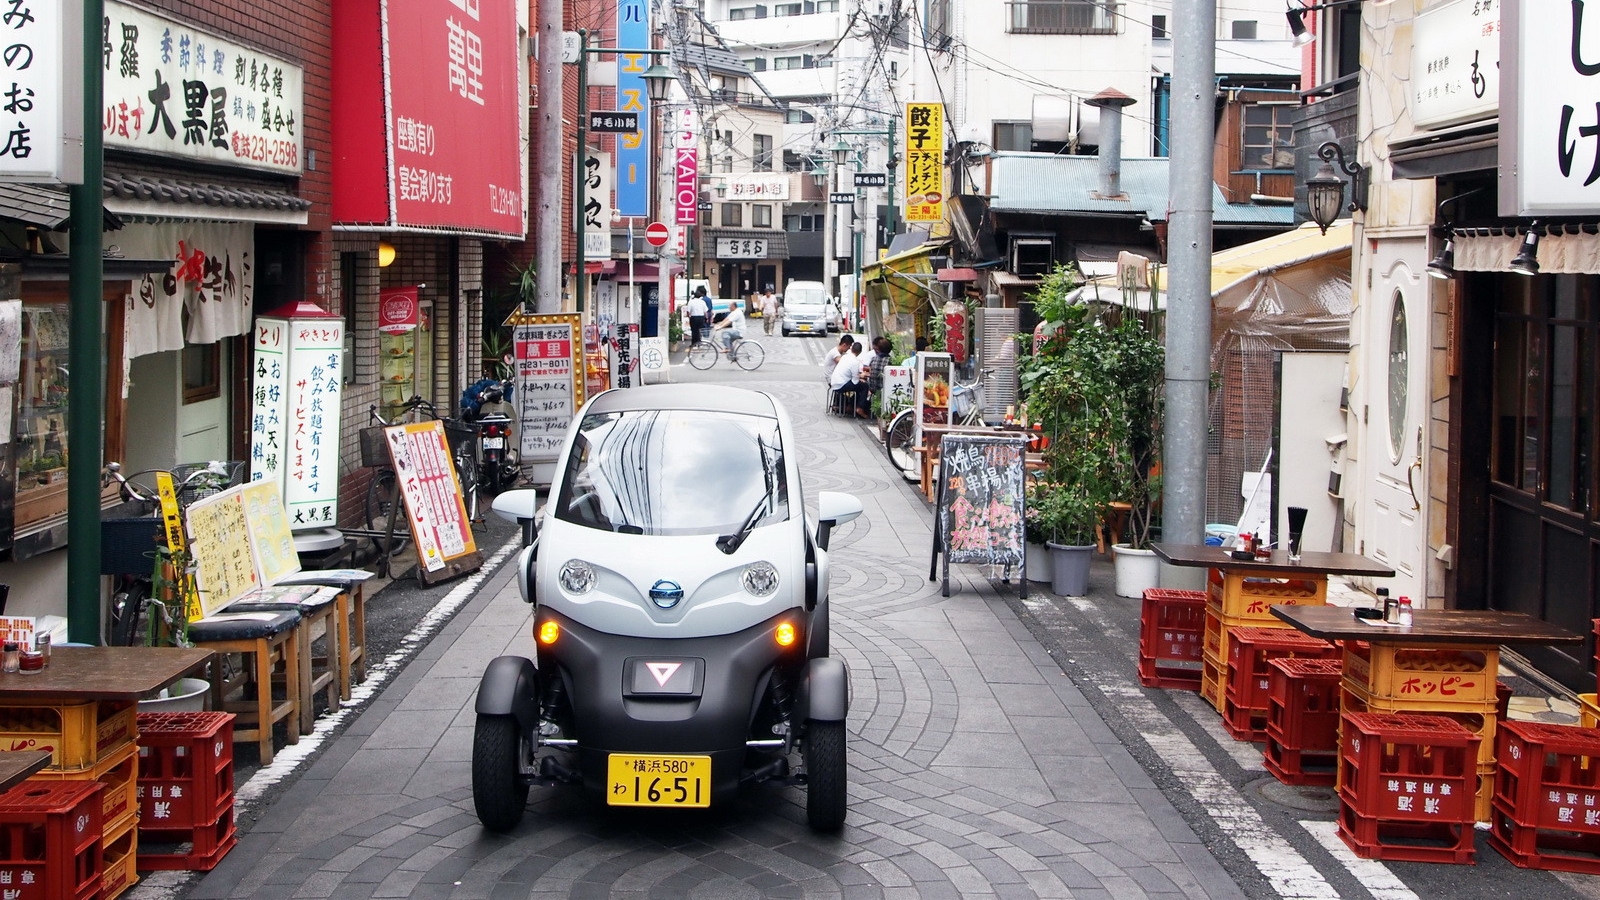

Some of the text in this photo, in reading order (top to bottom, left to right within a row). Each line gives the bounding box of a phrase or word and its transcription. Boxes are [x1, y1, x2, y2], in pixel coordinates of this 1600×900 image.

[160, 27, 225, 76] 季節料理
[235, 54, 283, 99] 刺身各種
[103, 96, 145, 140] ります
[148, 68, 229, 150] 大黒屋
[233, 95, 256, 122] 鍋物
[261, 97, 294, 136] 盛合せ
[592, 117, 636, 127] 野毛小路
[910, 107, 931, 148] 餃子
[397, 115, 435, 156] 座敷有り
[399, 165, 452, 205] 宴会承ります
[678, 150, 696, 222] KATOH
[910, 153, 920, 195] ラーメン
[260, 326, 280, 346] とり
[300, 328, 339, 341] やきとり
[327, 353, 339, 393] 宴会
[527, 360, 569, 369] 231-8011
[293, 379, 307, 480] サービスします
[308, 366, 324, 493] 飲み放題有ります
[293, 505, 332, 524] 大黒屋
[1400, 676, 1475, 695] ホッピー
[613, 776, 700, 803] わ 16-51
[1387, 779, 1451, 796] 専用通箱
[1396, 795, 1440, 814] 清酒
